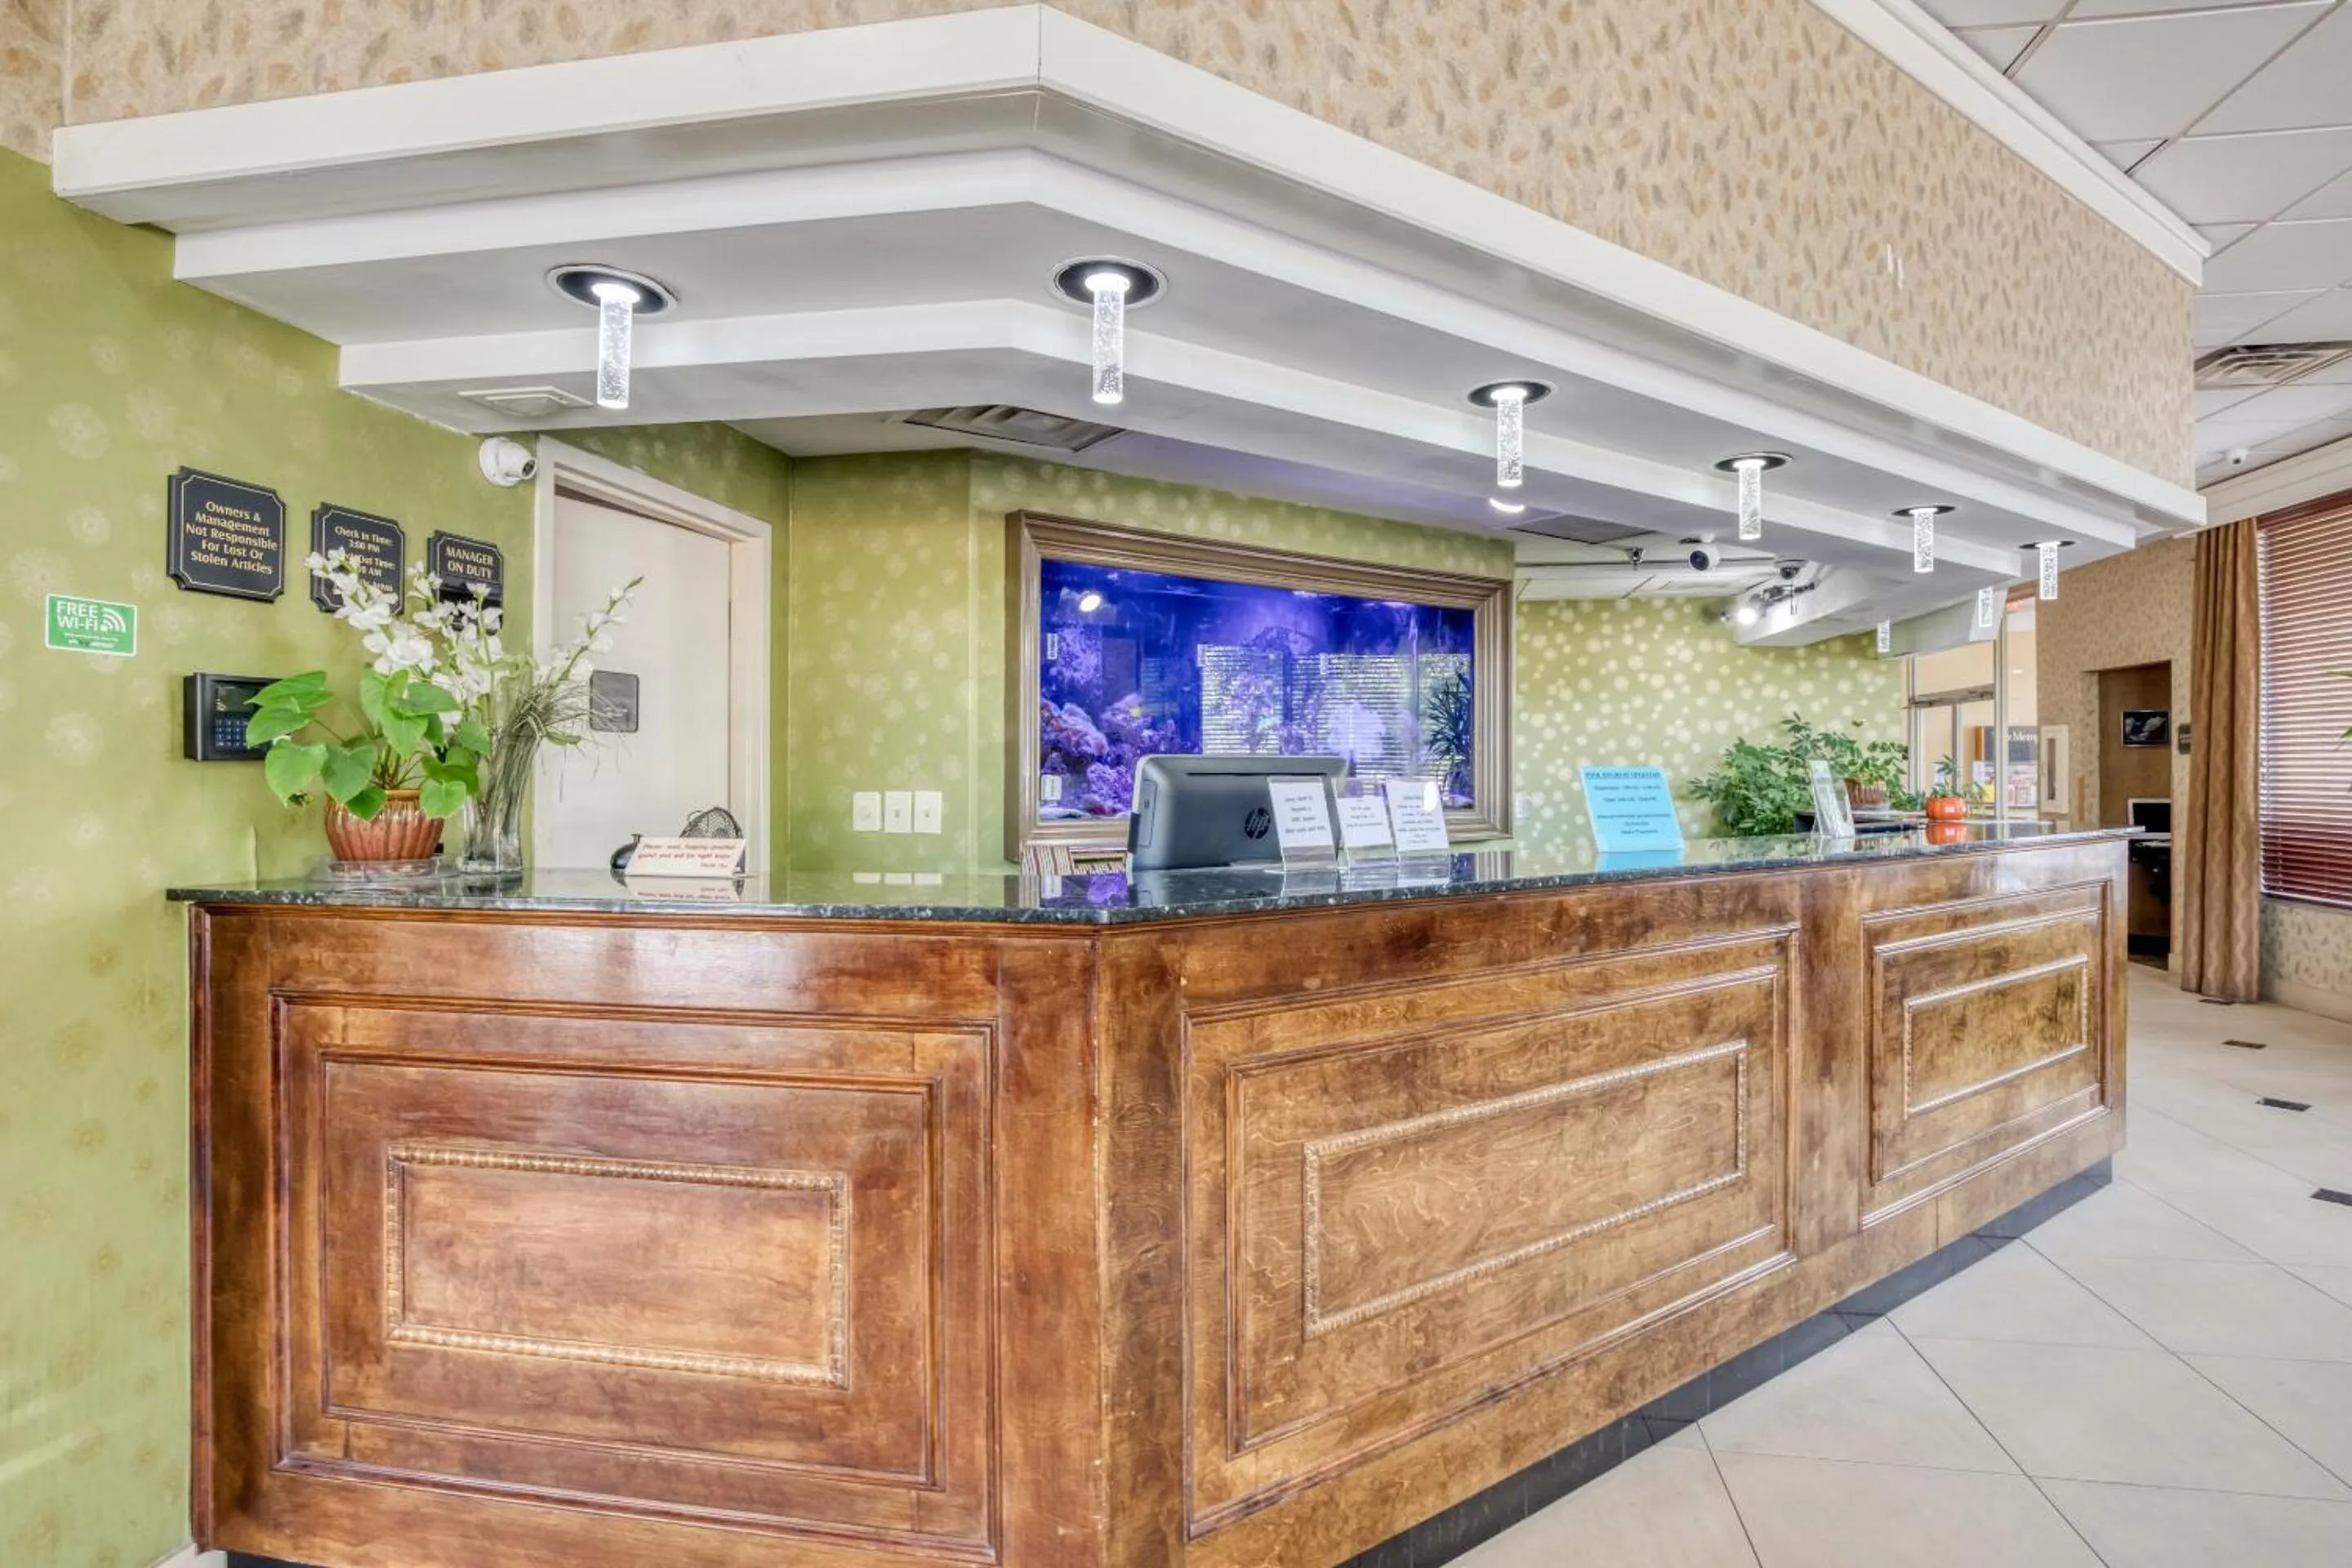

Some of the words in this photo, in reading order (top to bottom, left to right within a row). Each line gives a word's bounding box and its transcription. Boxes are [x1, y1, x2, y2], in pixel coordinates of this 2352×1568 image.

[205, 501, 250, 519] Owners
[253, 512, 261, 523] &
[195, 511, 270, 537] Management
[185, 523, 208, 537] Not
[211, 528, 278, 550] Responsible
[202, 539, 220, 551] For
[223, 543, 247, 557] Lost
[250, 549, 265, 560] Or
[368, 543, 381, 553] PM
[446, 546, 494, 567] MANAGER
[190, 550, 228, 567] Stolen
[231, 559, 273, 575] Articles
[448, 560, 464, 573] ON
[466, 564, 492, 579] DUTY
[56, 600, 99, 618] FREE
[57, 614, 99, 632] WI-FI
